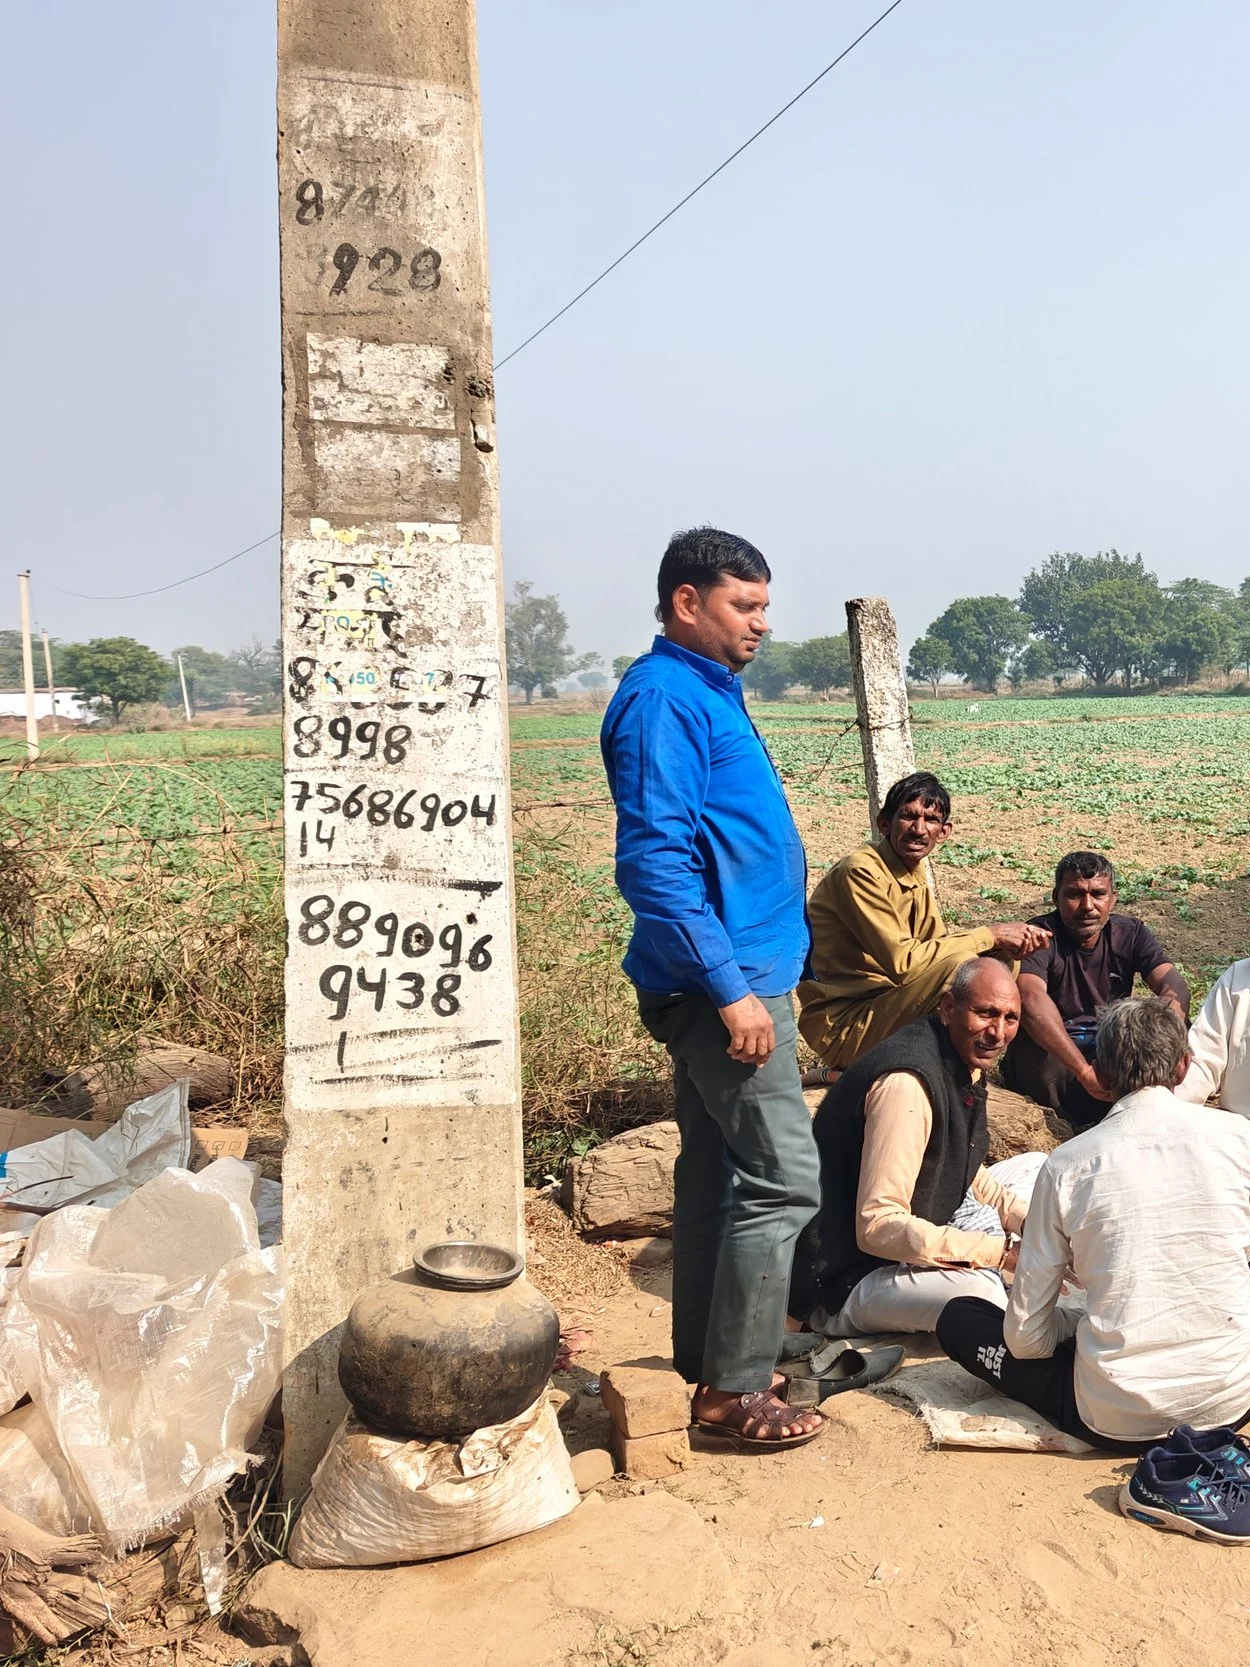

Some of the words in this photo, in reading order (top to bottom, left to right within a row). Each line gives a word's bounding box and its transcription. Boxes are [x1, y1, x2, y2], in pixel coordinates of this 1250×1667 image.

[293, 715, 412, 765] 8998
[290, 780, 497, 832] 75686904
[299, 819, 336, 858] 14
[299, 894, 493, 972] 889096
[319, 964, 462, 1021] 9438
[985, 1346, 996, 1370] DO
[993, 1344, 1007, 1379] JUST
